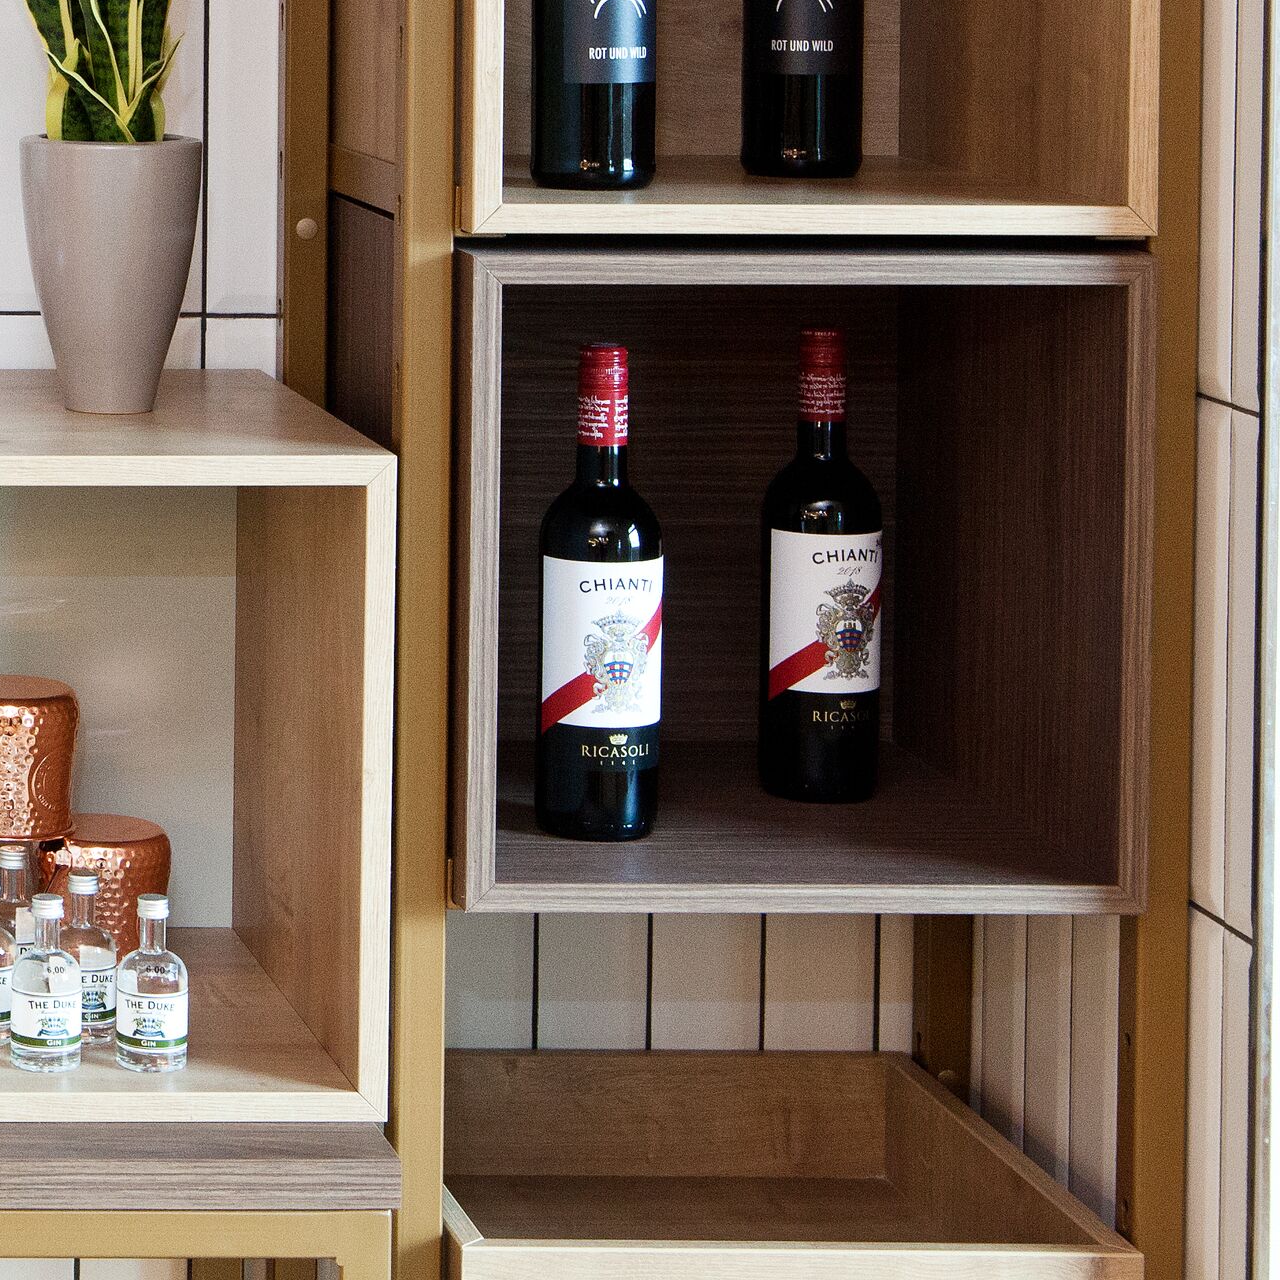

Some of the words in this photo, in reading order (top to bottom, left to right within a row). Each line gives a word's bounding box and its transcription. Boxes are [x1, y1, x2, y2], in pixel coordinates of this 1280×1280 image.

[771, 39, 788, 51] ROT
[790, 39, 810, 52] UND
[811, 40, 834, 52] WILD
[589, 47, 608, 60] ROT
[609, 47, 628, 60] UND
[629, 46, 647, 59] WILD
[811, 548, 879, 565] CHIANTI
[579, 578, 653, 594] CHIANTI
[581, 743, 649, 758] RICASOLI
[91, 974, 113, 984] DUKE
[28, 1000, 49, 1010] THE
[53, 1000, 77, 1009] DUKE
[125, 999, 144, 1010] THE
[147, 1000, 176, 1011] DUKE
[141, 1039, 157, 1048] GIN
